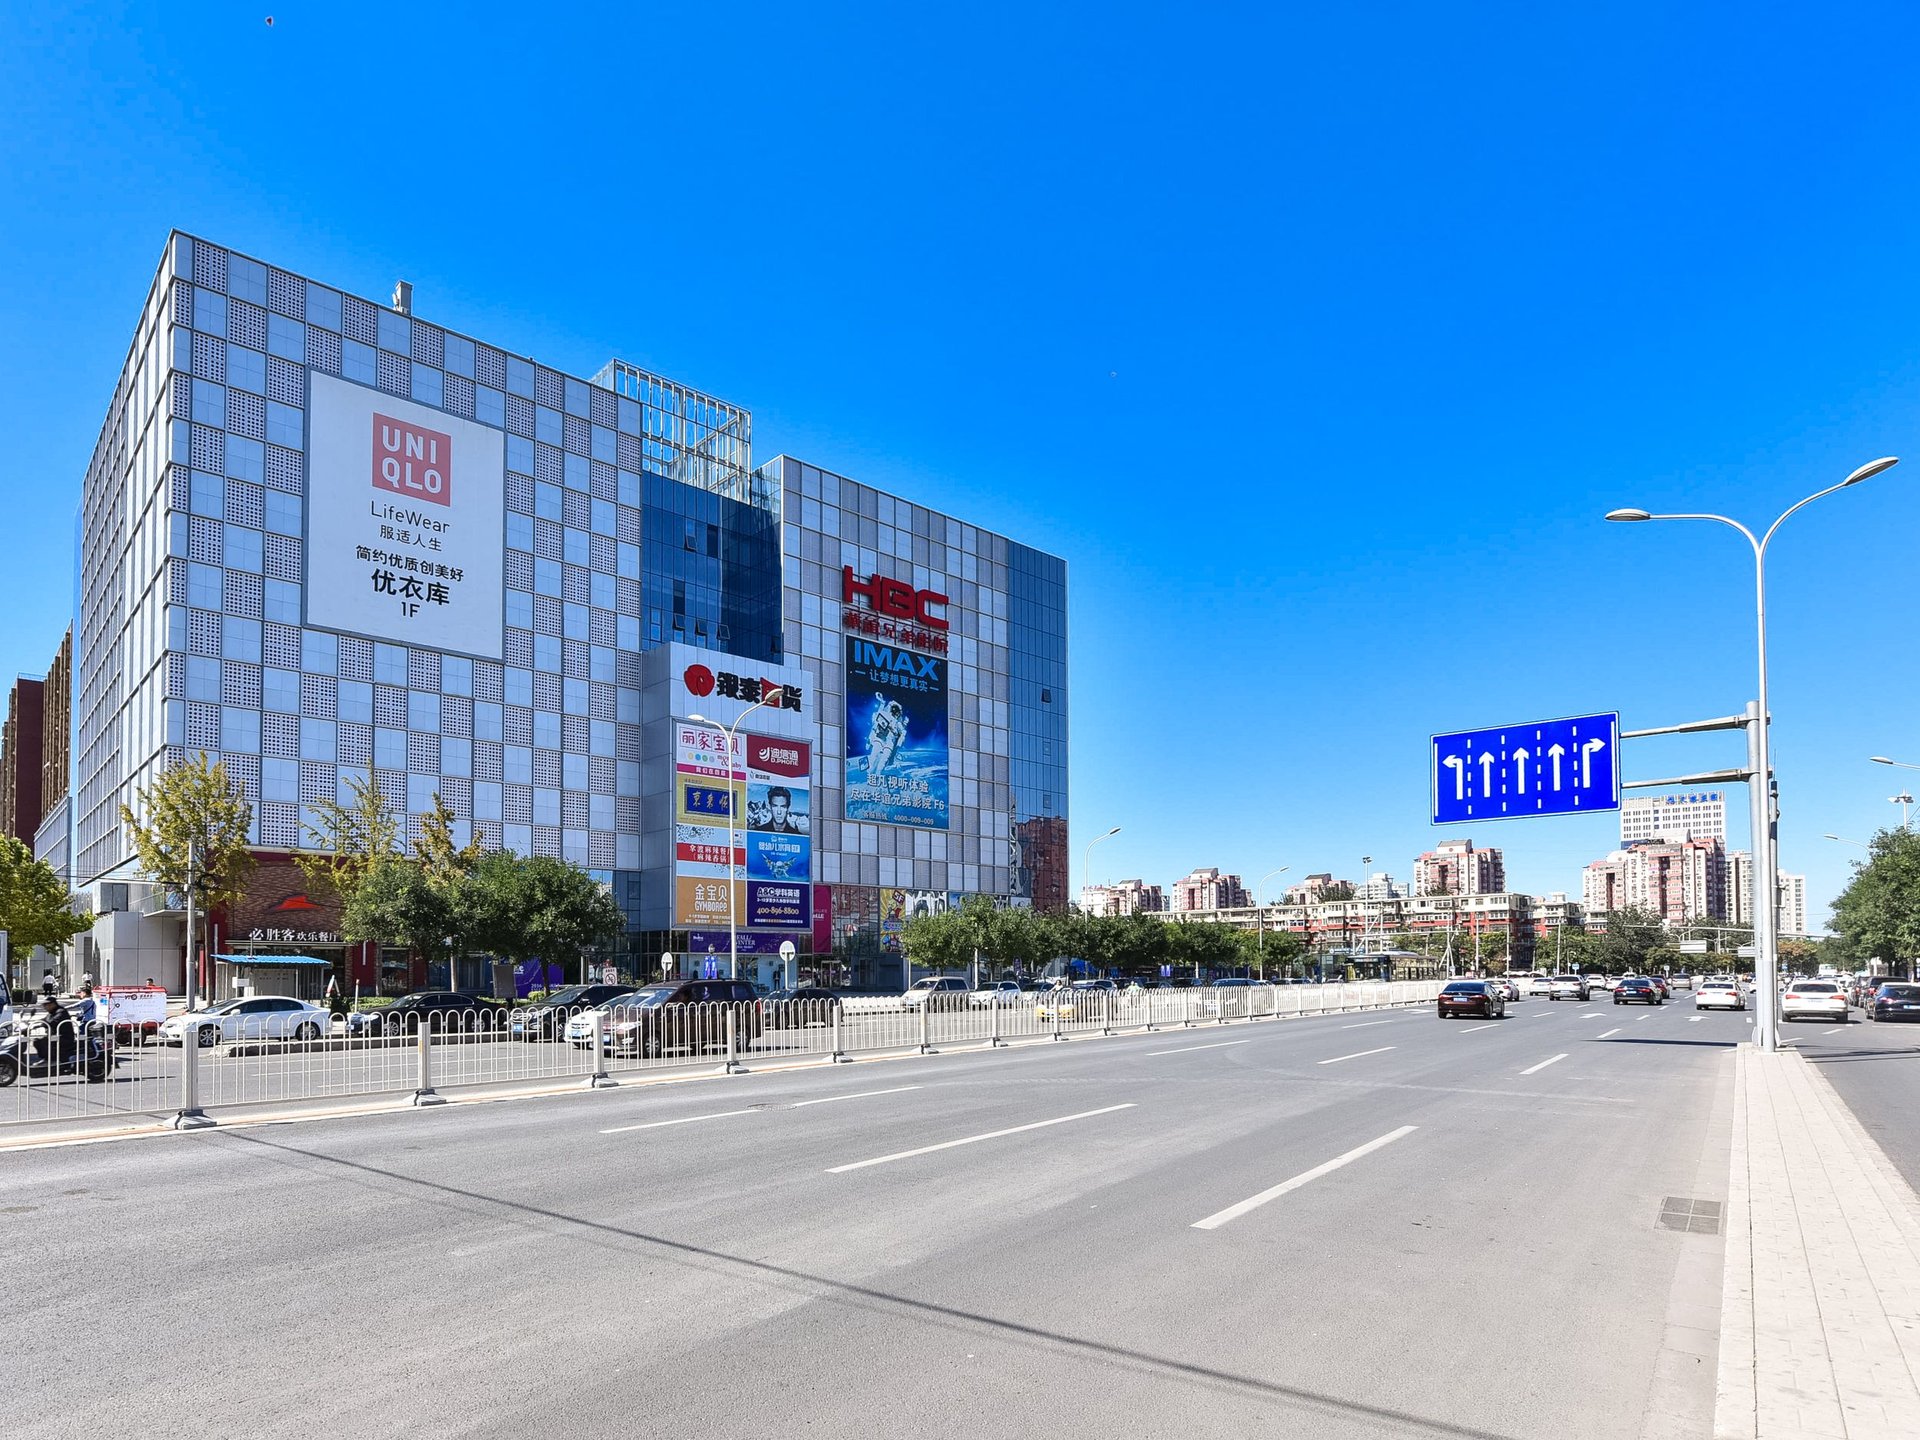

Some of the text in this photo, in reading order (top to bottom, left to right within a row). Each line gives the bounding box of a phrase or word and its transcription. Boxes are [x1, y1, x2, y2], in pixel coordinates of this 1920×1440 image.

[382, 425, 436, 464] UNI
[382, 457, 442, 494] QLO
[371, 500, 450, 534] LifeWear
[379, 524, 442, 552] 服适人生
[355, 545, 464, 582] 简约优质创美好
[371, 568, 451, 606] 优衣库
[844, 565, 949, 631] HBC
[401, 602, 421, 618] 1F
[854, 640, 939, 681] IMAX
[869, 669, 928, 692] 让梦想更真实
[682, 730, 740, 755] 丽家宝贝
[770, 747, 799, 761] 迪信通
[866, 773, 929, 793] 超凡视听体验
[850, 789, 945, 810] 尽在华谊兄弟影院 F6
[694, 883, 728, 902] 金宝贝
[249, 927, 338, 942] 必胜客欢乐餐厅
